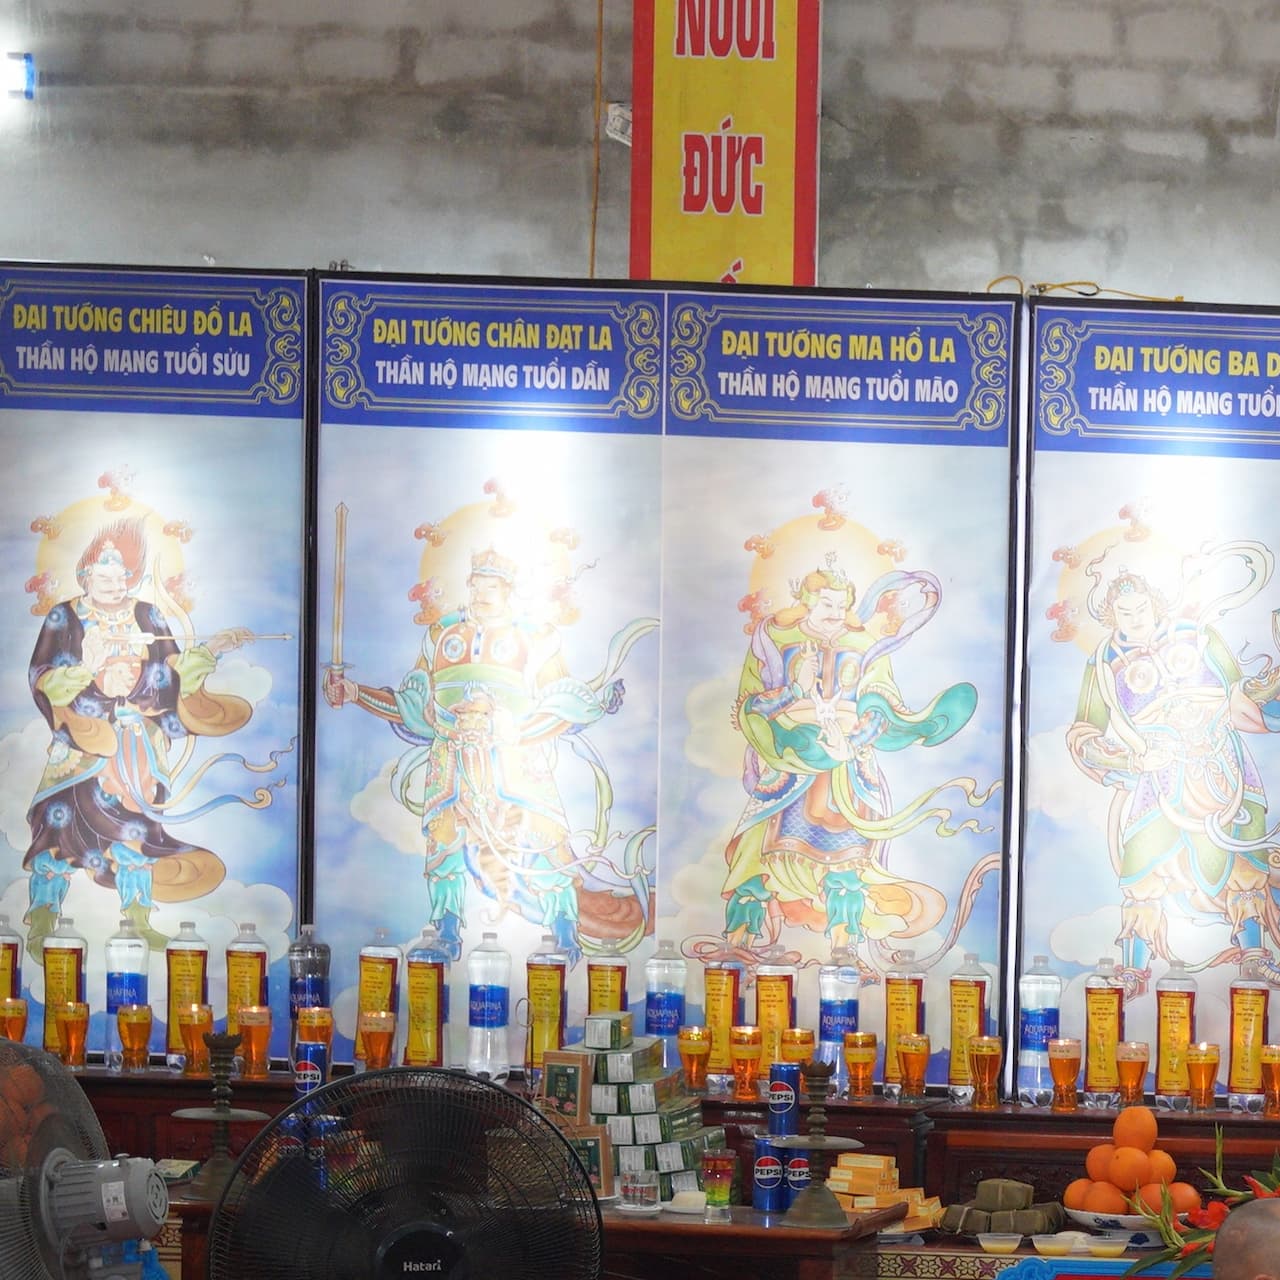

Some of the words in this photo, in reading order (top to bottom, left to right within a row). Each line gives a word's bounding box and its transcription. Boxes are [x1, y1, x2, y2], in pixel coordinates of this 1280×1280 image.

[683, 117, 763, 215] ĐỨC
[13, 304, 47, 333] ĐẠI
[53, 302, 122, 332] TƯỚNG
[129, 304, 187, 335] CHIÊU
[194, 301, 223, 336] ĐỔ
[229, 312, 253, 337] LA
[373, 318, 407, 348] ĐẠI
[412, 316, 480, 347] TƯỚNG
[486, 318, 540, 349] CHÂN
[546, 324, 583, 353] ĐẠT
[589, 326, 612, 351] LA
[16, 339, 65, 371] THẦN
[71, 344, 98, 375] HỘ
[104, 349, 158, 376] MẠNG
[165, 342, 207, 376] TUỔI
[721, 330, 759, 360] ĐẠI
[765, 328, 842, 360] TƯỚNG
[849, 335, 884, 361] MA
[890, 326, 923, 362] HỔ
[929, 337, 956, 363] LA
[1094, 346, 1133, 376] ĐẠI
[1140, 344, 1221, 375] TƯỚNG
[1228, 351, 1260, 378] BA
[375, 354, 424, 385] THẦN
[430, 357, 457, 389] HỘ
[462, 363, 518, 391] MẠNG
[523, 356, 566, 390] TUỔI
[571, 359, 610, 391] DẦN
[718, 365, 767, 397] THẦN
[772, 369, 800, 401] HỘ
[805, 375, 861, 402] MẠNG
[865, 368, 910, 401] TUỔI
[915, 375, 959, 403] MÃO
[1088, 381, 1138, 413] THẦN
[1143, 385, 1171, 417] HỘ
[1176, 389, 1233, 418] MẠNG
[823, 1015, 856, 1026] AQUAFINA
[1024, 1024, 1057, 1035] AQUAFINA
[787, 1170, 811, 1178] PEPS
[403, 1260, 441, 1272] Hatari
